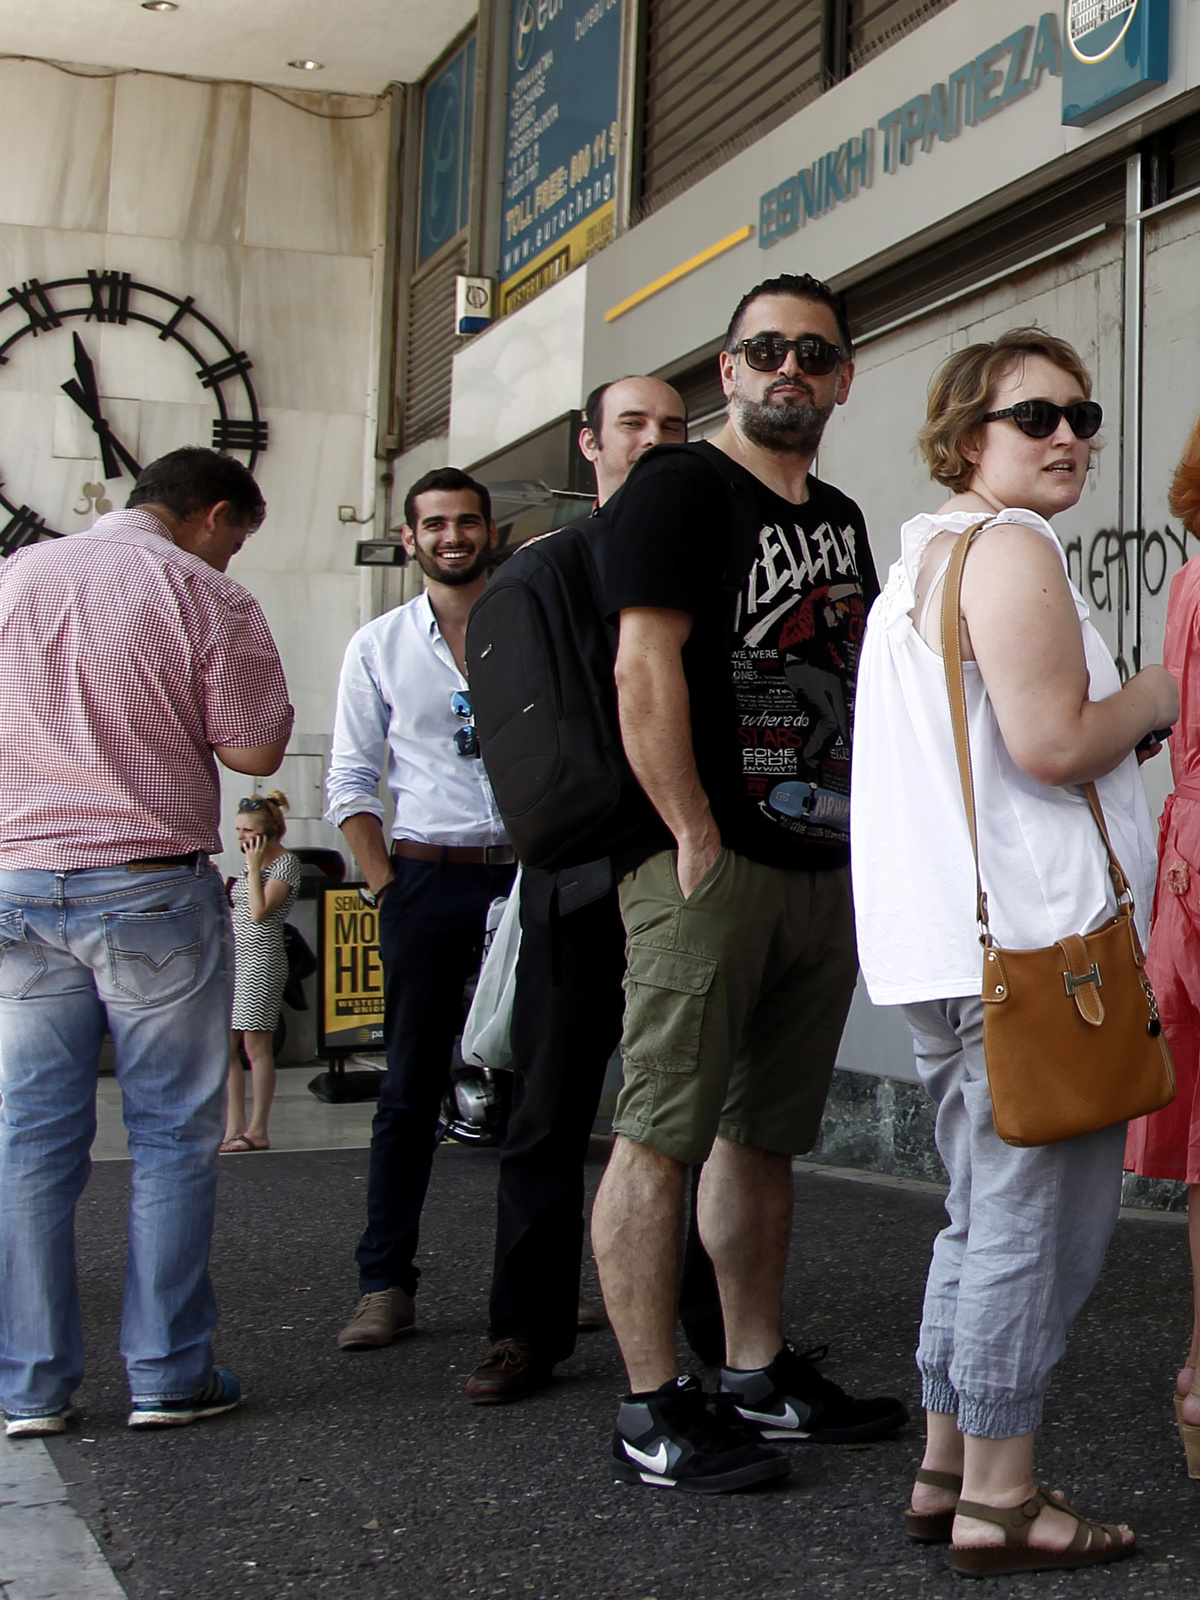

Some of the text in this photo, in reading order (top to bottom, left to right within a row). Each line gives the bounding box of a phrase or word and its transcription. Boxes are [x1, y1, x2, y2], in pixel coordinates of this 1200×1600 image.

[759, 12, 1062, 249] ΕΘΝΙΚΗ ΤΡΑΠΕΖΑ
[504, 171, 616, 272] www.eurochang
[505, 195, 533, 241] TOLL
[748, 649, 779, 660] WERE
[731, 660, 753, 670] THE
[739, 710, 809, 728] where do
[737, 727, 803, 749] STARS
[742, 748, 795, 758] COME
[743, 757, 798, 766] FROM
[335, 912, 377, 944] MO
[335, 945, 381, 993] HE
[371, 1030, 384, 1040] pa
